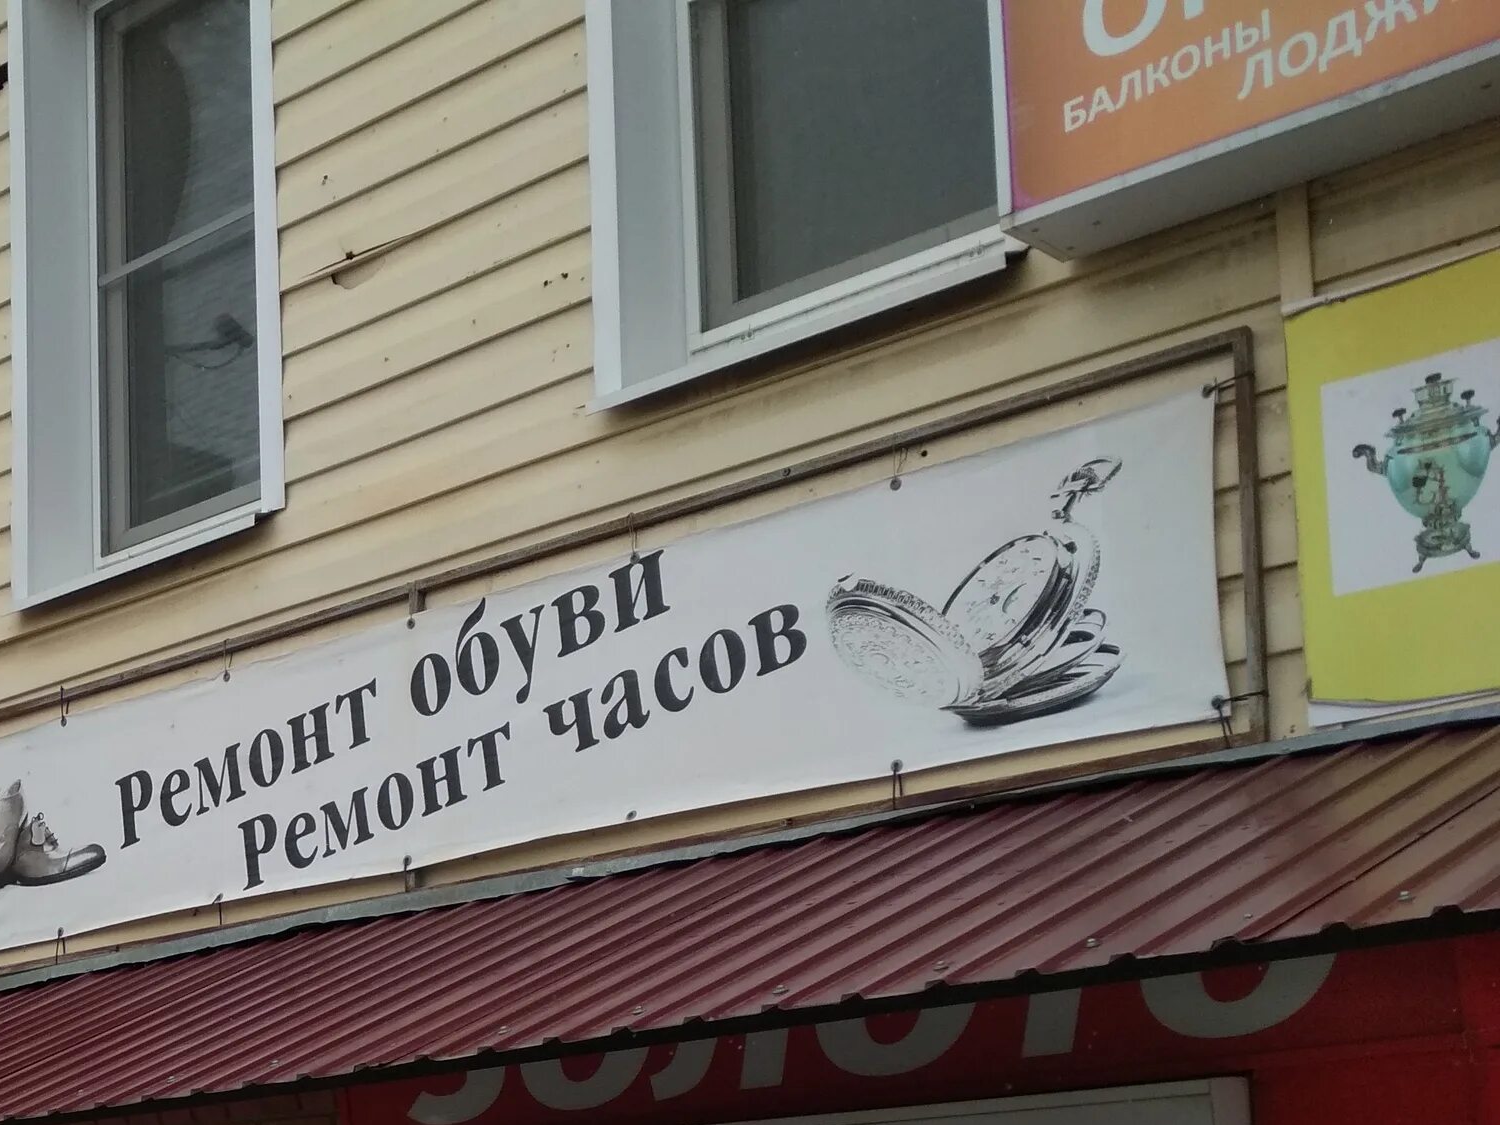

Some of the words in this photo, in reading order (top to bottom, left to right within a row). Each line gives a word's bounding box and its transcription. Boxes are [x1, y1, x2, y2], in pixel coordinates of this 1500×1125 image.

[1062, 8, 1271, 133] БАЛКОНЫ
[114, 677, 377, 850] Ремонт
[409, 548, 672, 717] обуви
[237, 720, 511, 891] Ремонт
[542, 603, 808, 754] часов
